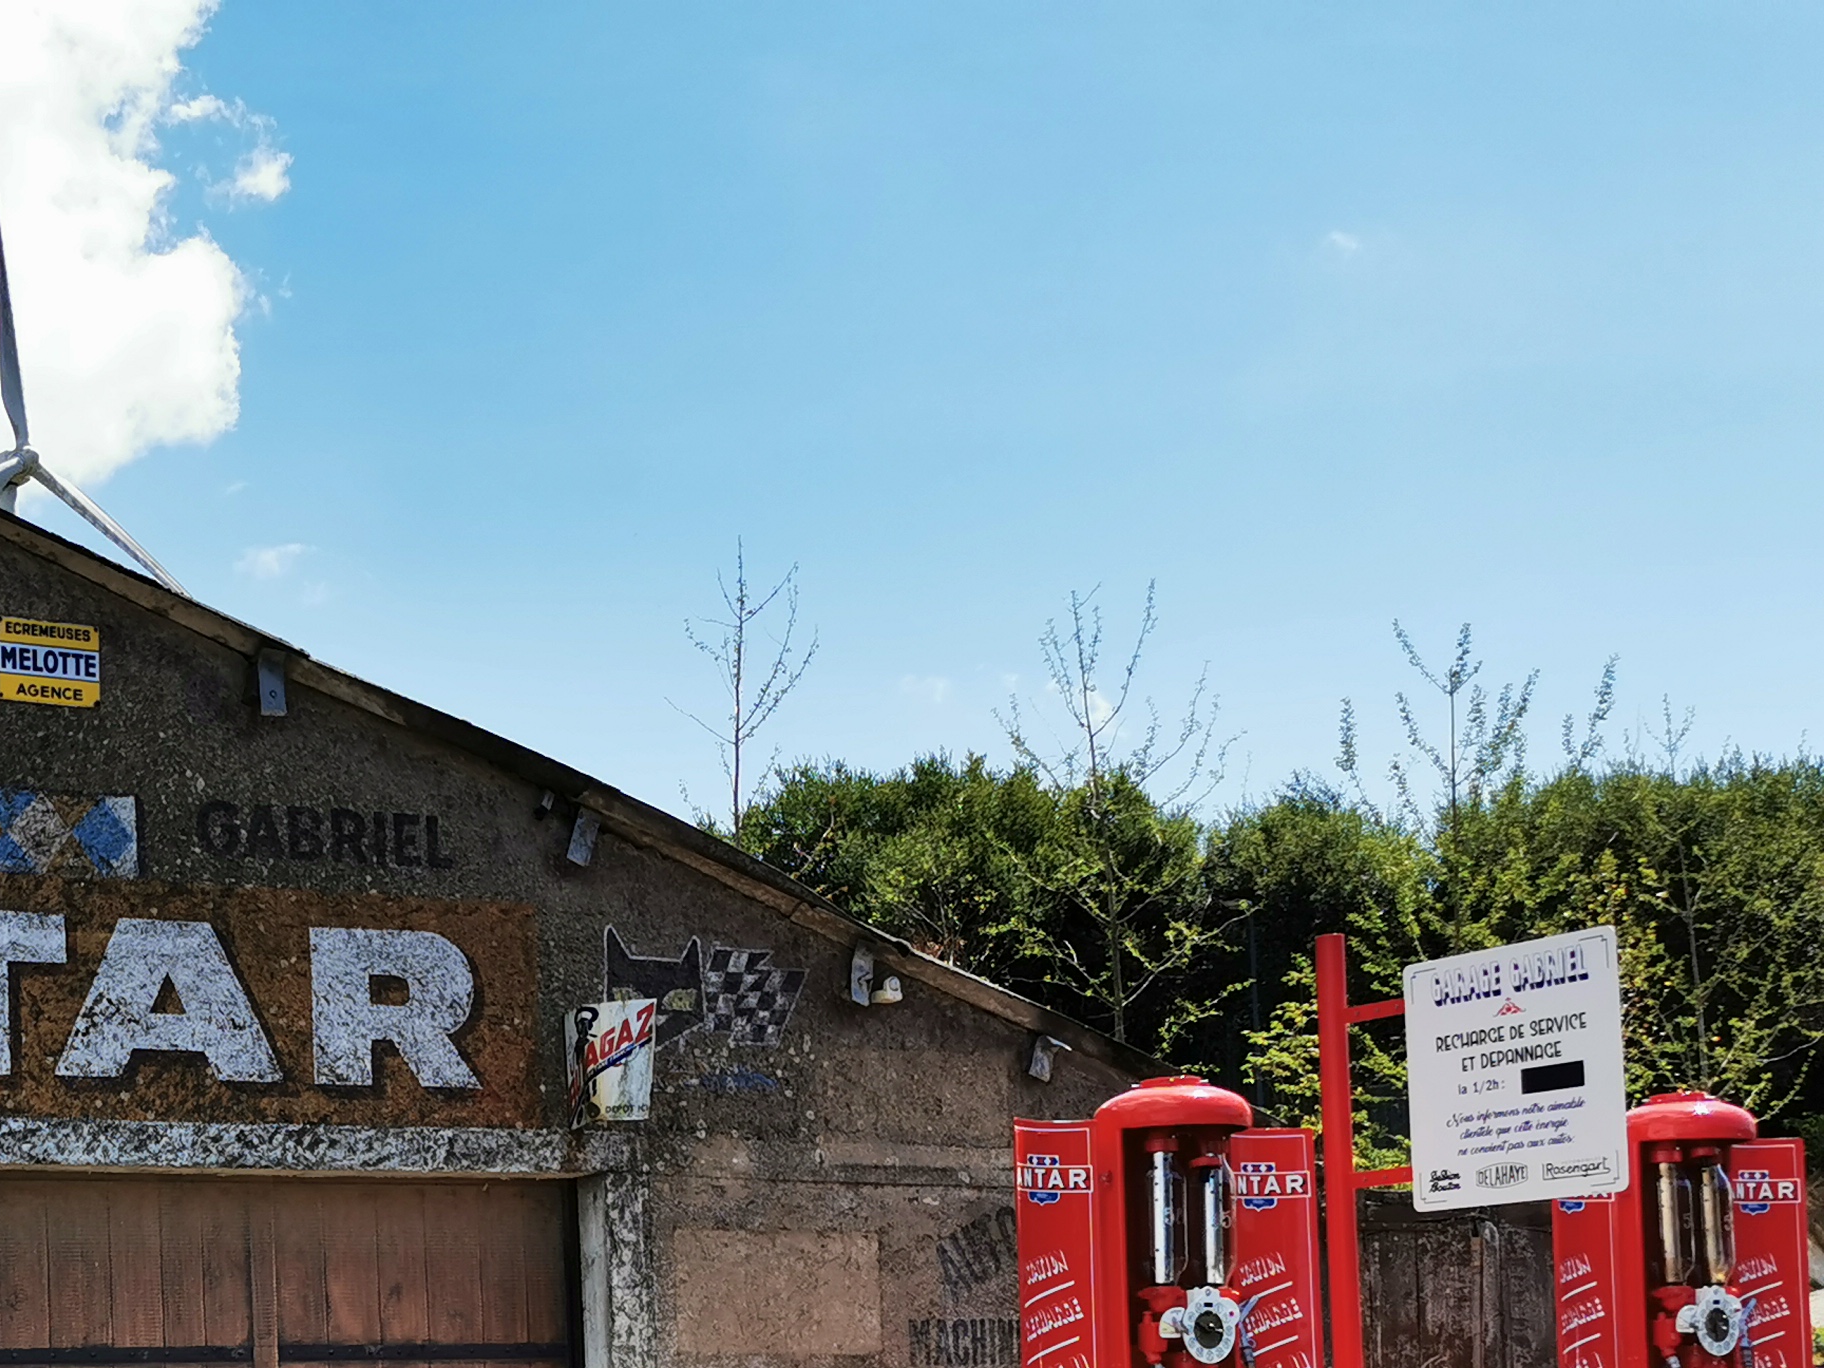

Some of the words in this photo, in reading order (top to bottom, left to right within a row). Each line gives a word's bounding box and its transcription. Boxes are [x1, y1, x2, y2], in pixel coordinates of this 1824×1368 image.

[5, 621, 91, 642] ECREMEUSES
[1, 645, 97, 678] MELOTTE
[16, 683, 84, 701] AGENCE
[198, 802, 455, 870] GABRIEL
[1431, 960, 1502, 1007] GARAGE
[1509, 944, 1589, 993] GABRIEL
[584, 1002, 654, 1072] AGAZ
[1435, 1026, 1505, 1053] RECHARGE
[1510, 1024, 1524, 1040] DE
[1529, 1012, 1587, 1037] SERVICE
[1461, 1056, 1475, 1072] ET
[1480, 1041, 1562, 1069] DEPANNAGE
[1017, 1166, 1087, 1189] ANTAR
[1478, 1160, 1527, 1186] DELAHAYE
[1545, 1156, 1609, 1179] Rosengart
[1237, 1174, 1304, 1195] NTAR
[1732, 1181, 1795, 1200] NTAR
